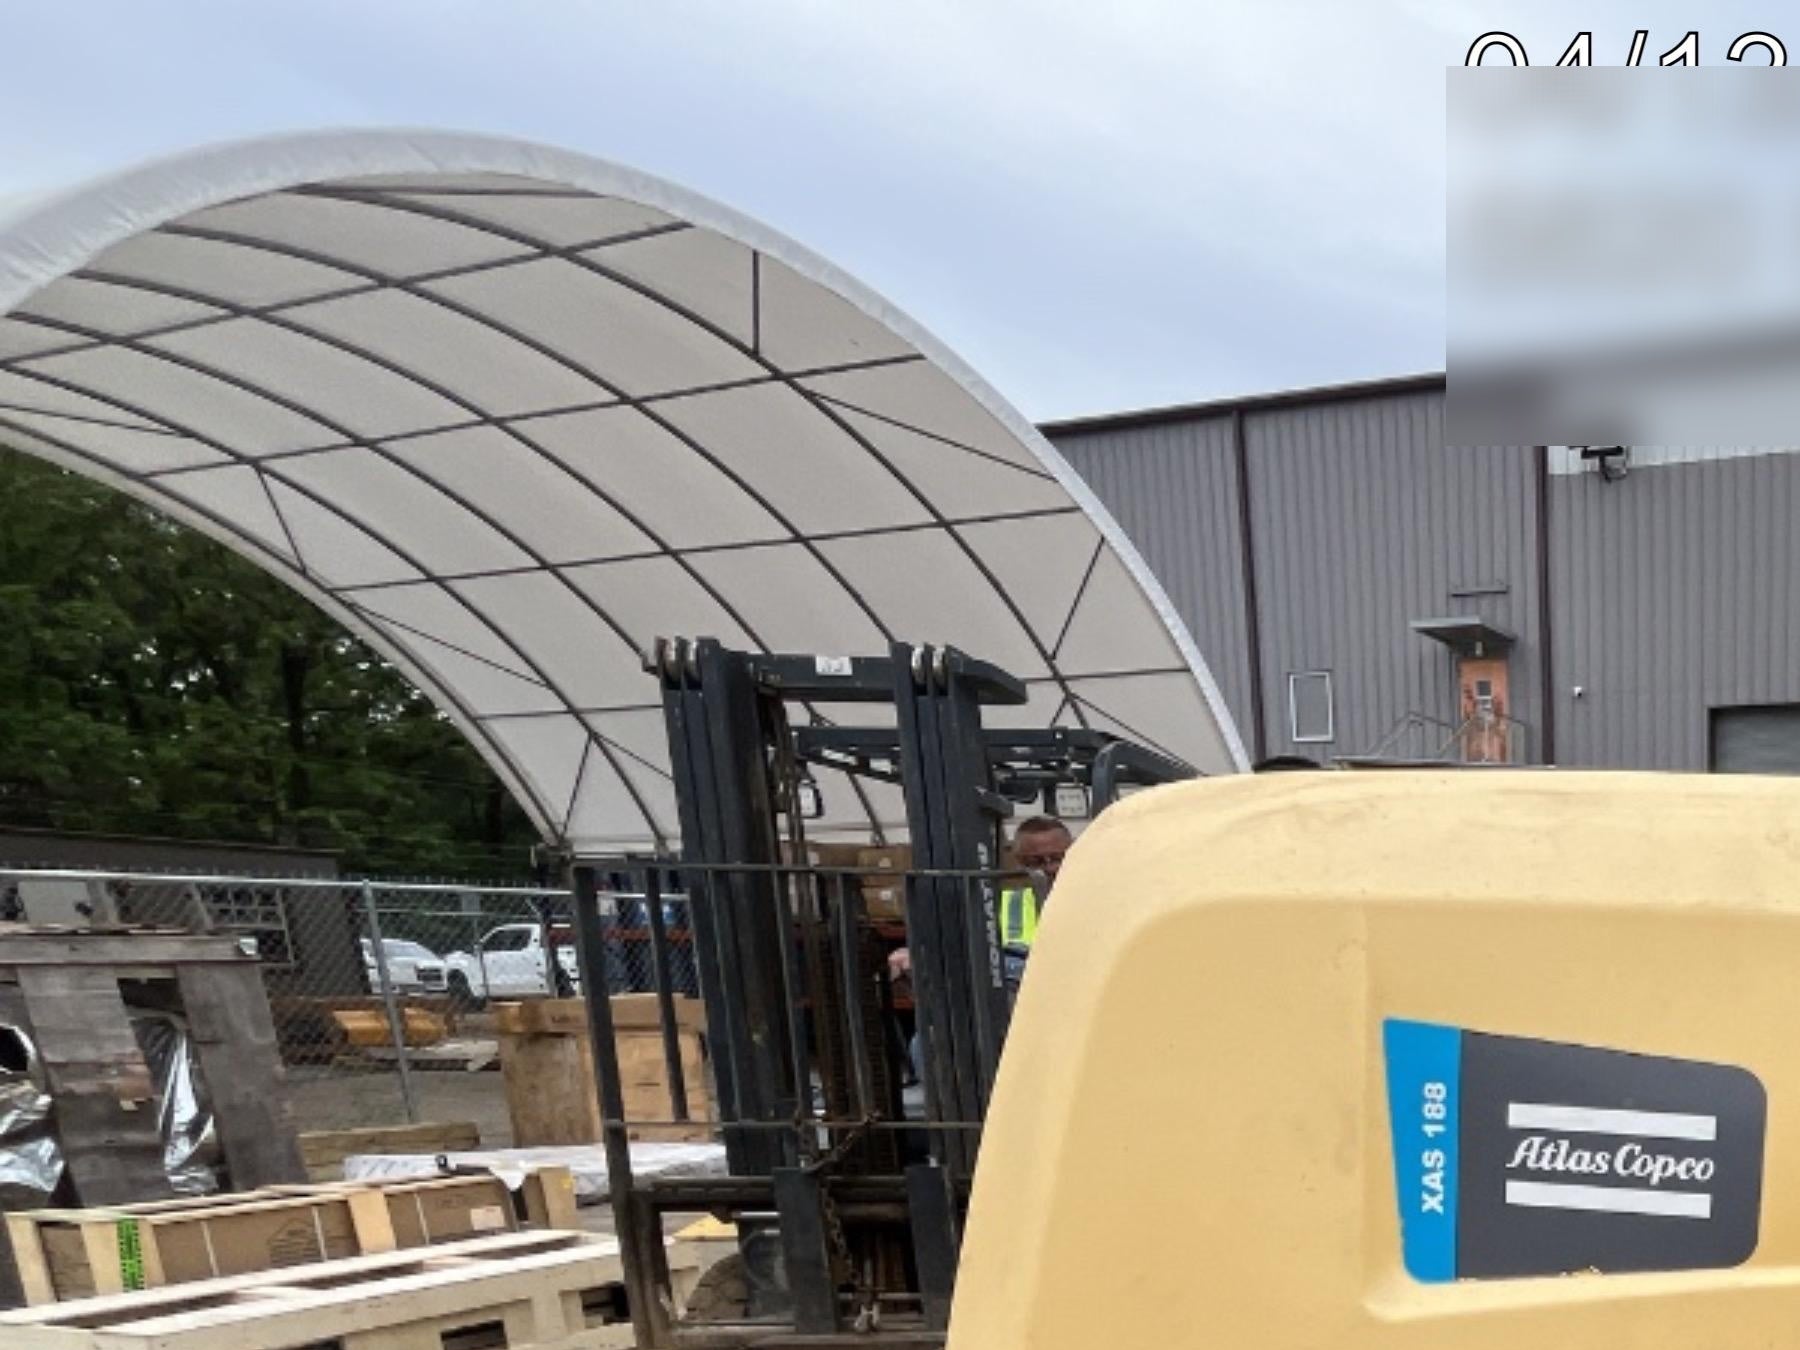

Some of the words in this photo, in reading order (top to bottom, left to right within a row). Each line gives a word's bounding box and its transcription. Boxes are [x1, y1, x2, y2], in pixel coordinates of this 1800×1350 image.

[1422, 1082, 1447, 1137] 188
[1422, 1149, 1447, 1214] XAS
[1505, 1136, 1611, 1174] Atlas
[1613, 1142, 1715, 1185] Copco
